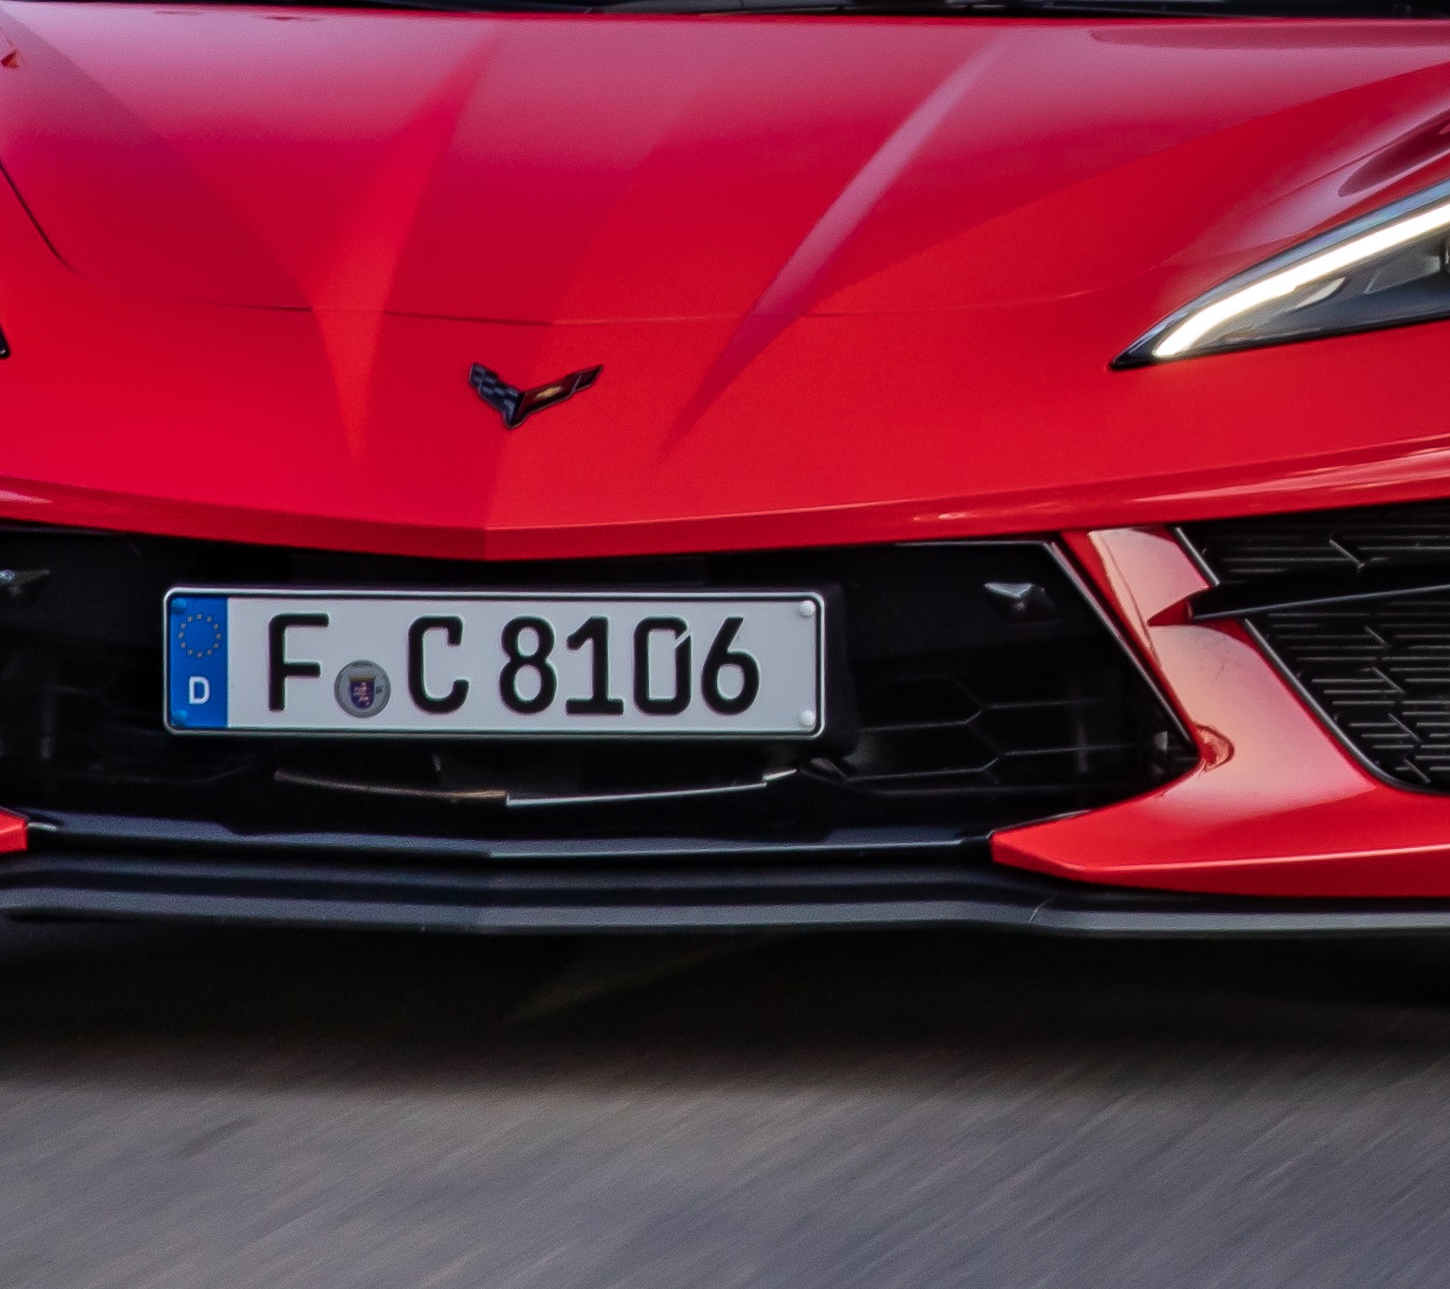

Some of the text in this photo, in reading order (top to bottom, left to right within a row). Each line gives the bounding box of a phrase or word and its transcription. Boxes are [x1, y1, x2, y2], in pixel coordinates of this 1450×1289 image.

[189, 676, 211, 705] D
[269, 613, 330, 712] F
[408, 616, 470, 714] C
[500, 616, 760, 716] 8106
